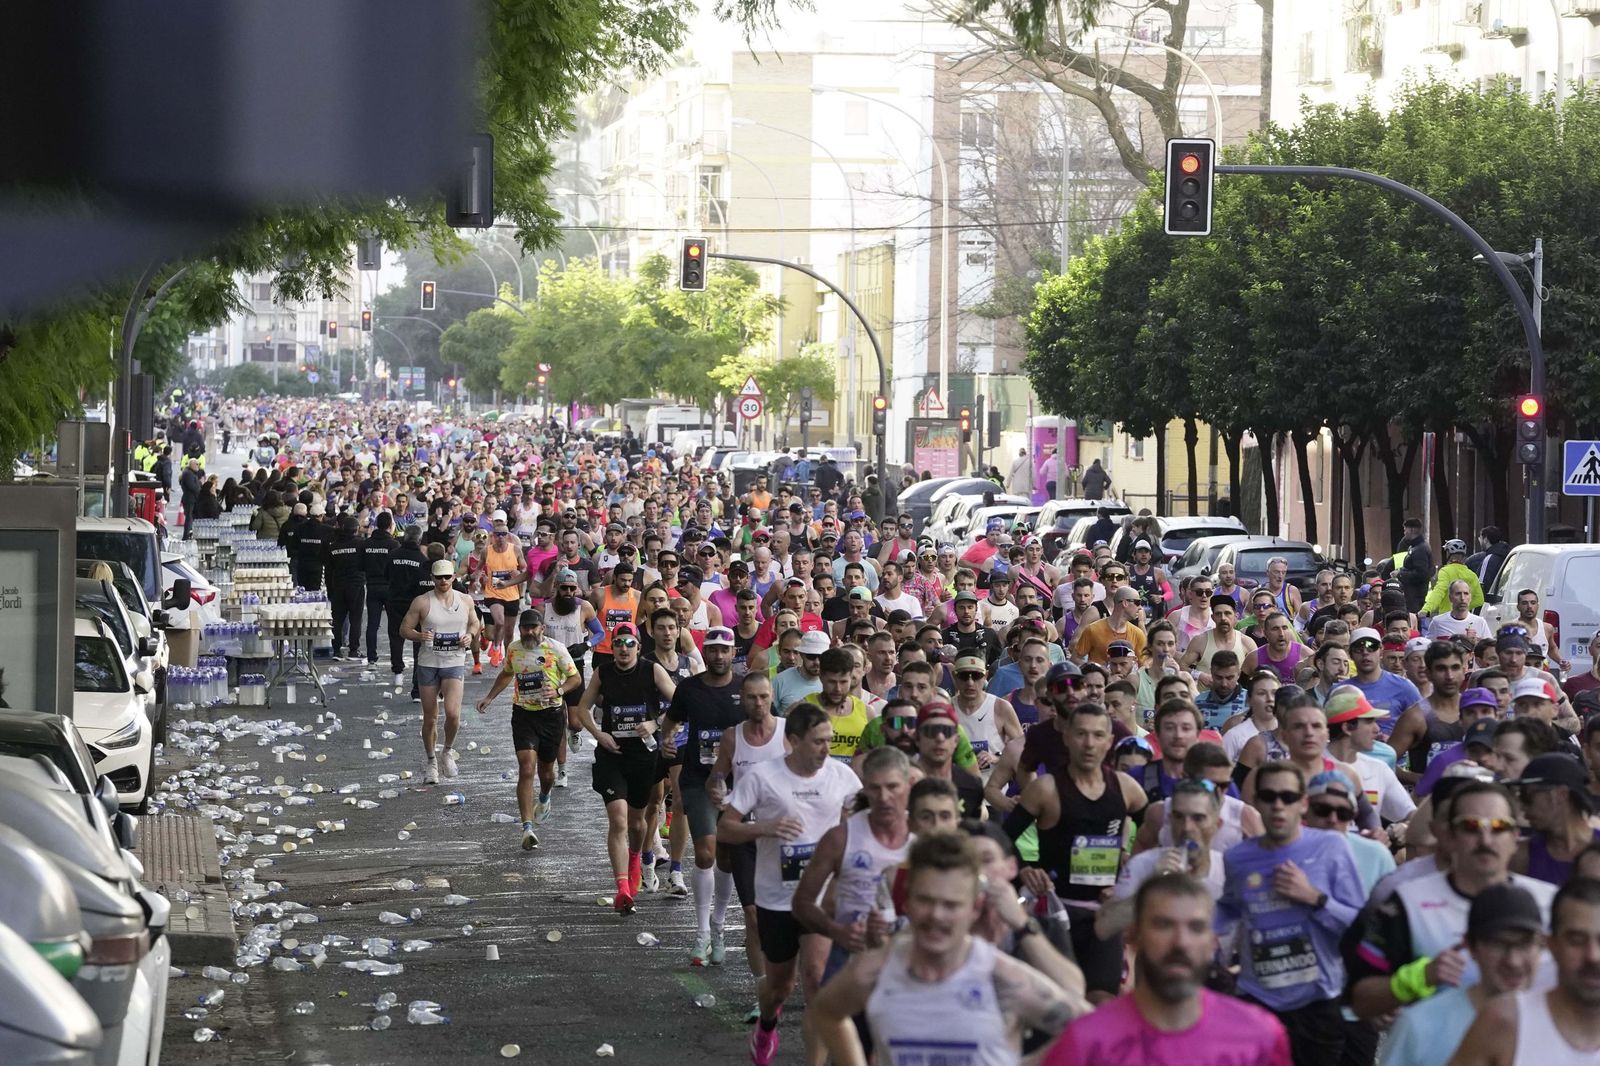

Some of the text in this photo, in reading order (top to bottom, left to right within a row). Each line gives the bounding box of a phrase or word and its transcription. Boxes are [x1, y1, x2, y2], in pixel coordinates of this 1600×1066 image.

[393, 559, 420, 567] VOLUNTEER
[0, 586, 19, 596] Jacob
[1089, 838, 1117, 846] ZURICH
[1253, 951, 1317, 976] FERNANDO
